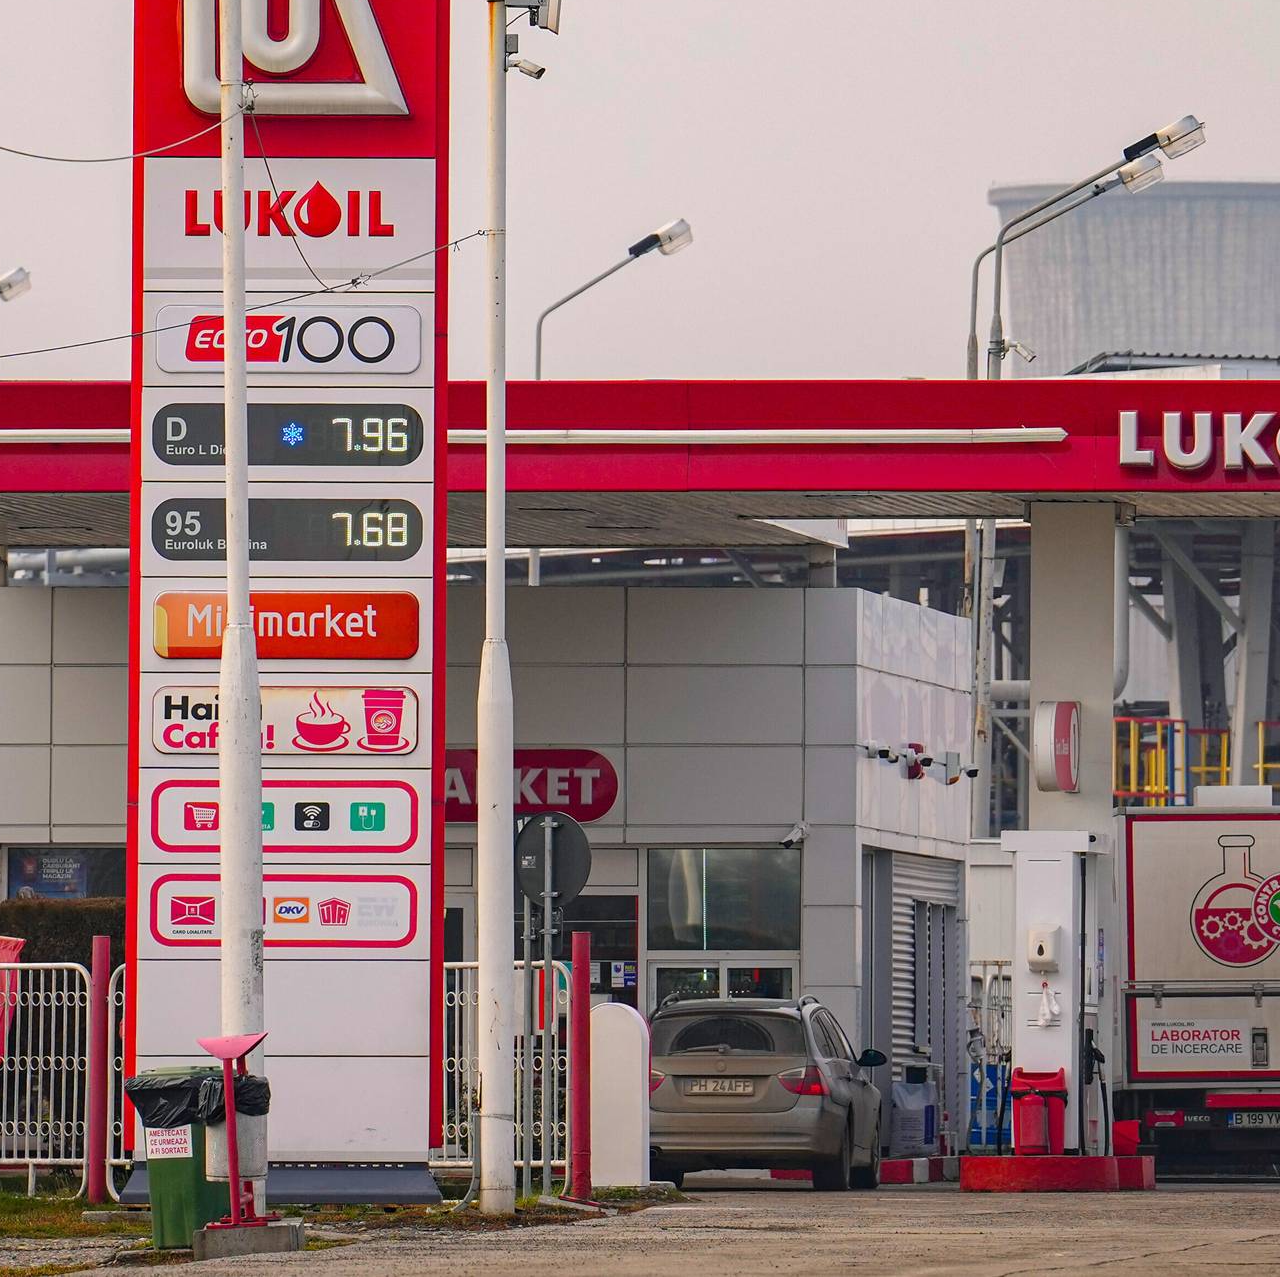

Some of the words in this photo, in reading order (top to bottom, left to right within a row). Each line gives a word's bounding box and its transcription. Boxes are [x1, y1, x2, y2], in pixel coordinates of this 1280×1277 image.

[195, 329, 268, 349] ECO
[276, 316, 395, 363] 100
[166, 417, 187, 441] D
[332, 417, 408, 452] 7.96
[166, 444, 195, 455] Euro
[199, 445, 206, 455] L
[165, 510, 201, 536] 95
[332, 512, 408, 547] 7.68
[165, 539, 214, 550] Euroluk
[217, 539, 268, 550] Bina
[187, 603, 377, 637] Miimarket
[163, 722, 275, 749] Caf!
[445, 768, 601, 805] AKET
[278, 906, 305, 914] DKV
[320, 899, 349, 924] UTA
[1151, 1029, 1241, 1041] LABORATOR
[1151, 1044, 1168, 1054] DE
[690, 1080, 708, 1091] PH
[1235, 1113, 1243, 1124] B
[1247, 1113, 1264, 1124] 199
[149, 1129, 187, 1137] AMESTECATE
